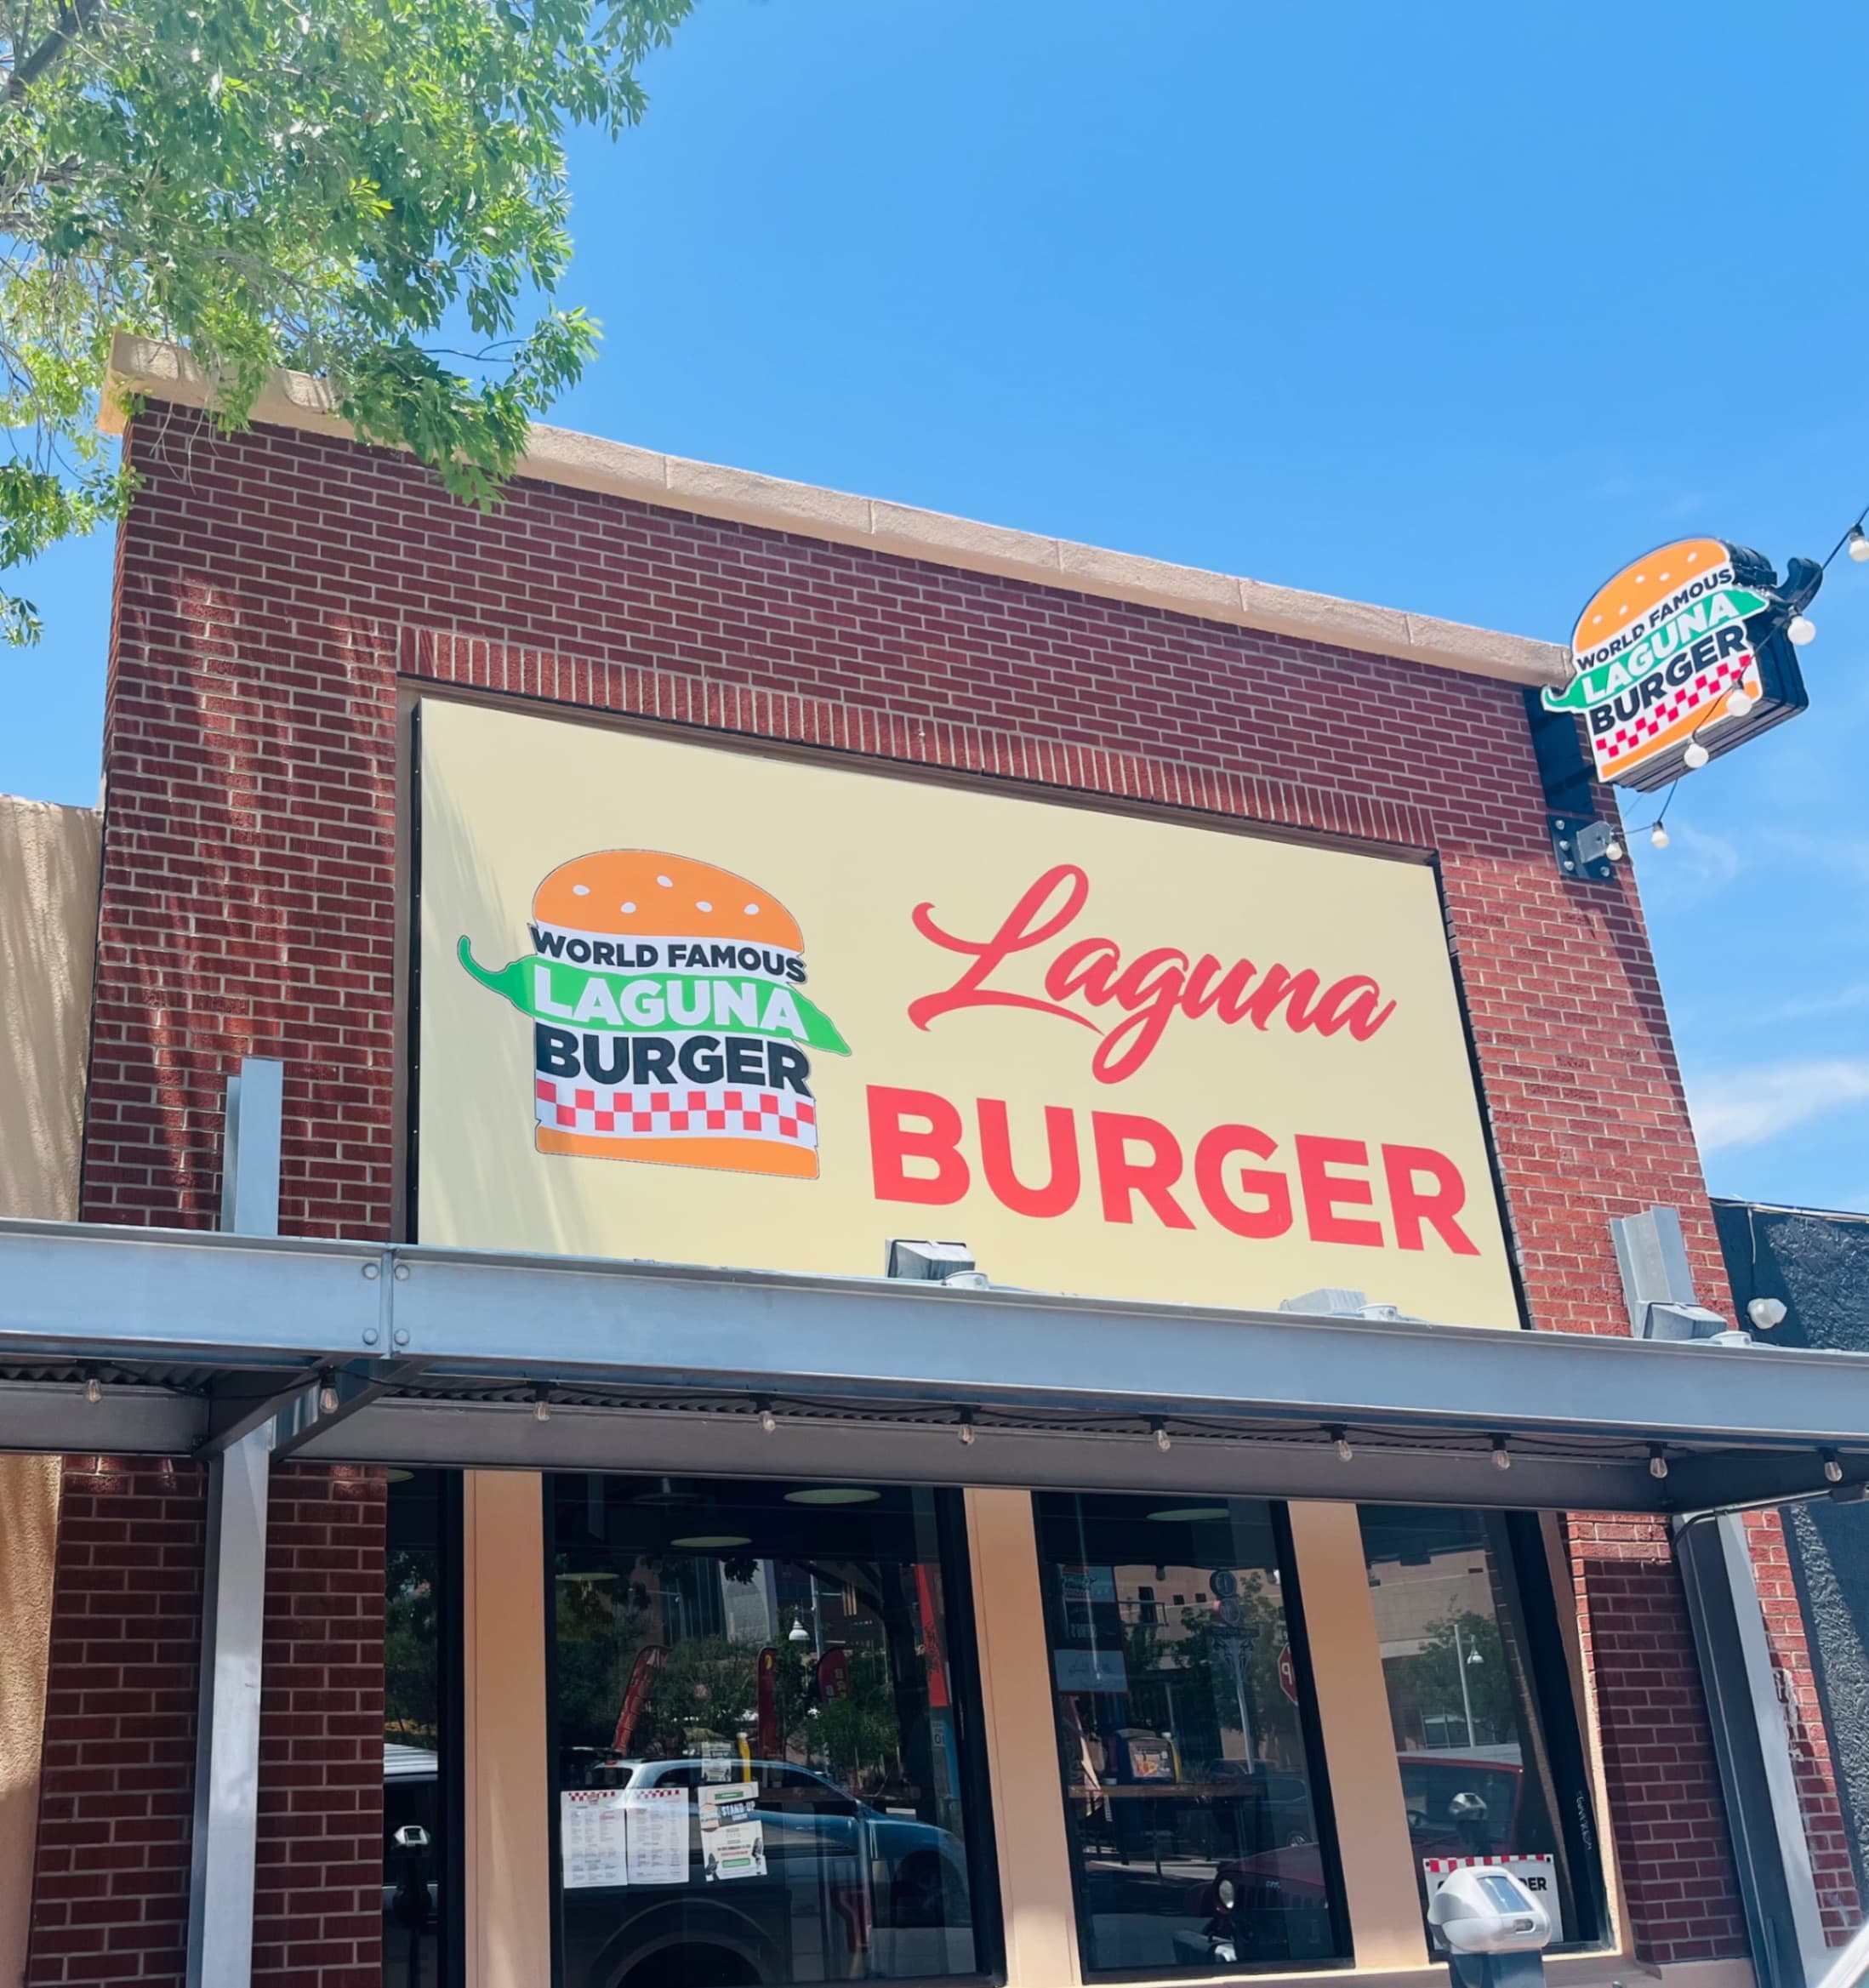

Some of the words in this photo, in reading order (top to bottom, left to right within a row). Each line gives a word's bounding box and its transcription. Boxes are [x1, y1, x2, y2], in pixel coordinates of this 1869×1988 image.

[1576, 624, 1645, 671] WORLD
[1650, 568, 1733, 627] FAMOUS
[1581, 593, 1741, 703] LAGUNA
[1589, 624, 1748, 735] BURGER
[528, 925, 658, 967] WORLD
[668, 943, 807, 983] FAMOUS
[533, 964, 810, 1041] LAGUNA
[907, 863, 1398, 1085] Laguna
[535, 1022, 814, 1099] BURGER
[865, 1084, 1482, 1256] BURGER
